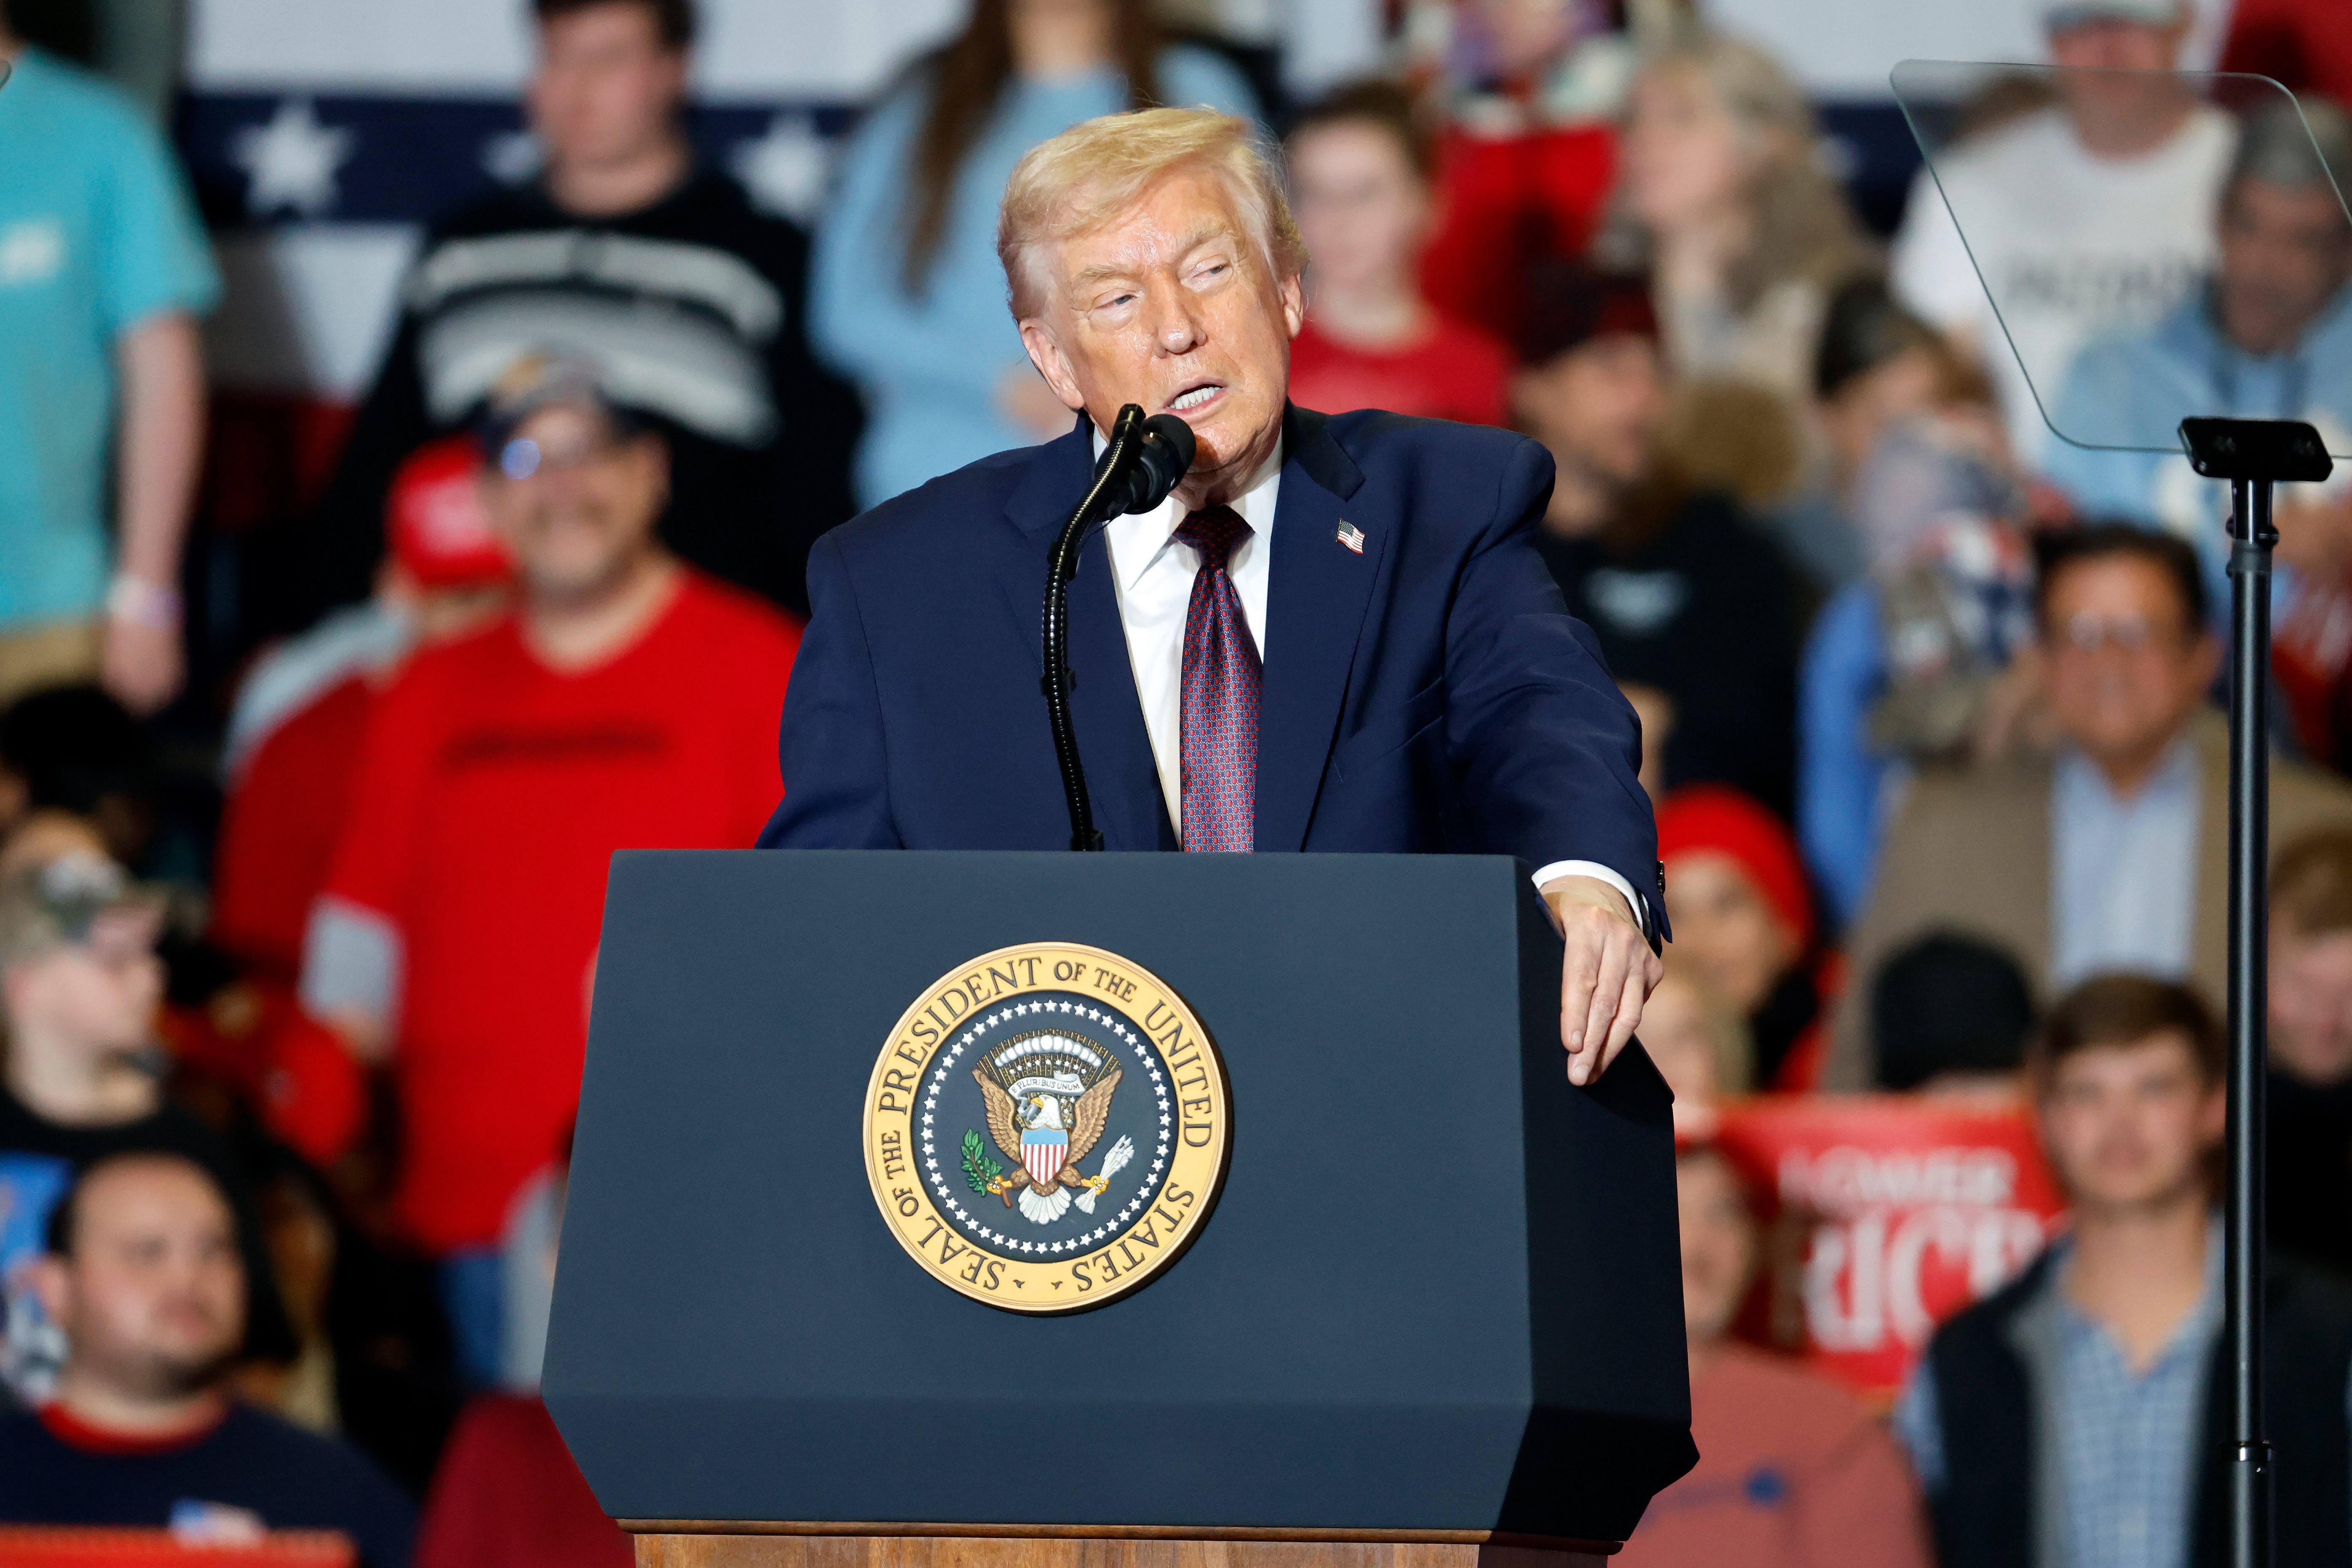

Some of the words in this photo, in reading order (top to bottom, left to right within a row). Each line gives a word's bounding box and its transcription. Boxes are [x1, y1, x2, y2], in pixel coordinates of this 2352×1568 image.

[1053, 960, 1086, 981] OF
[1093, 966, 1137, 1003] THE
[878, 957, 1041, 1115] PRESIDENT
[1016, 1078, 1056, 1089] PLURIBUS
[1057, 1082, 1080, 1091] UNUM
[1145, 999, 1212, 1147] UNITED
[881, 1130, 905, 1180] THE
[891, 1187, 919, 1217] OF
[917, 1215, 1006, 1290] SEAL
[1071, 1182, 1194, 1292] STATES
